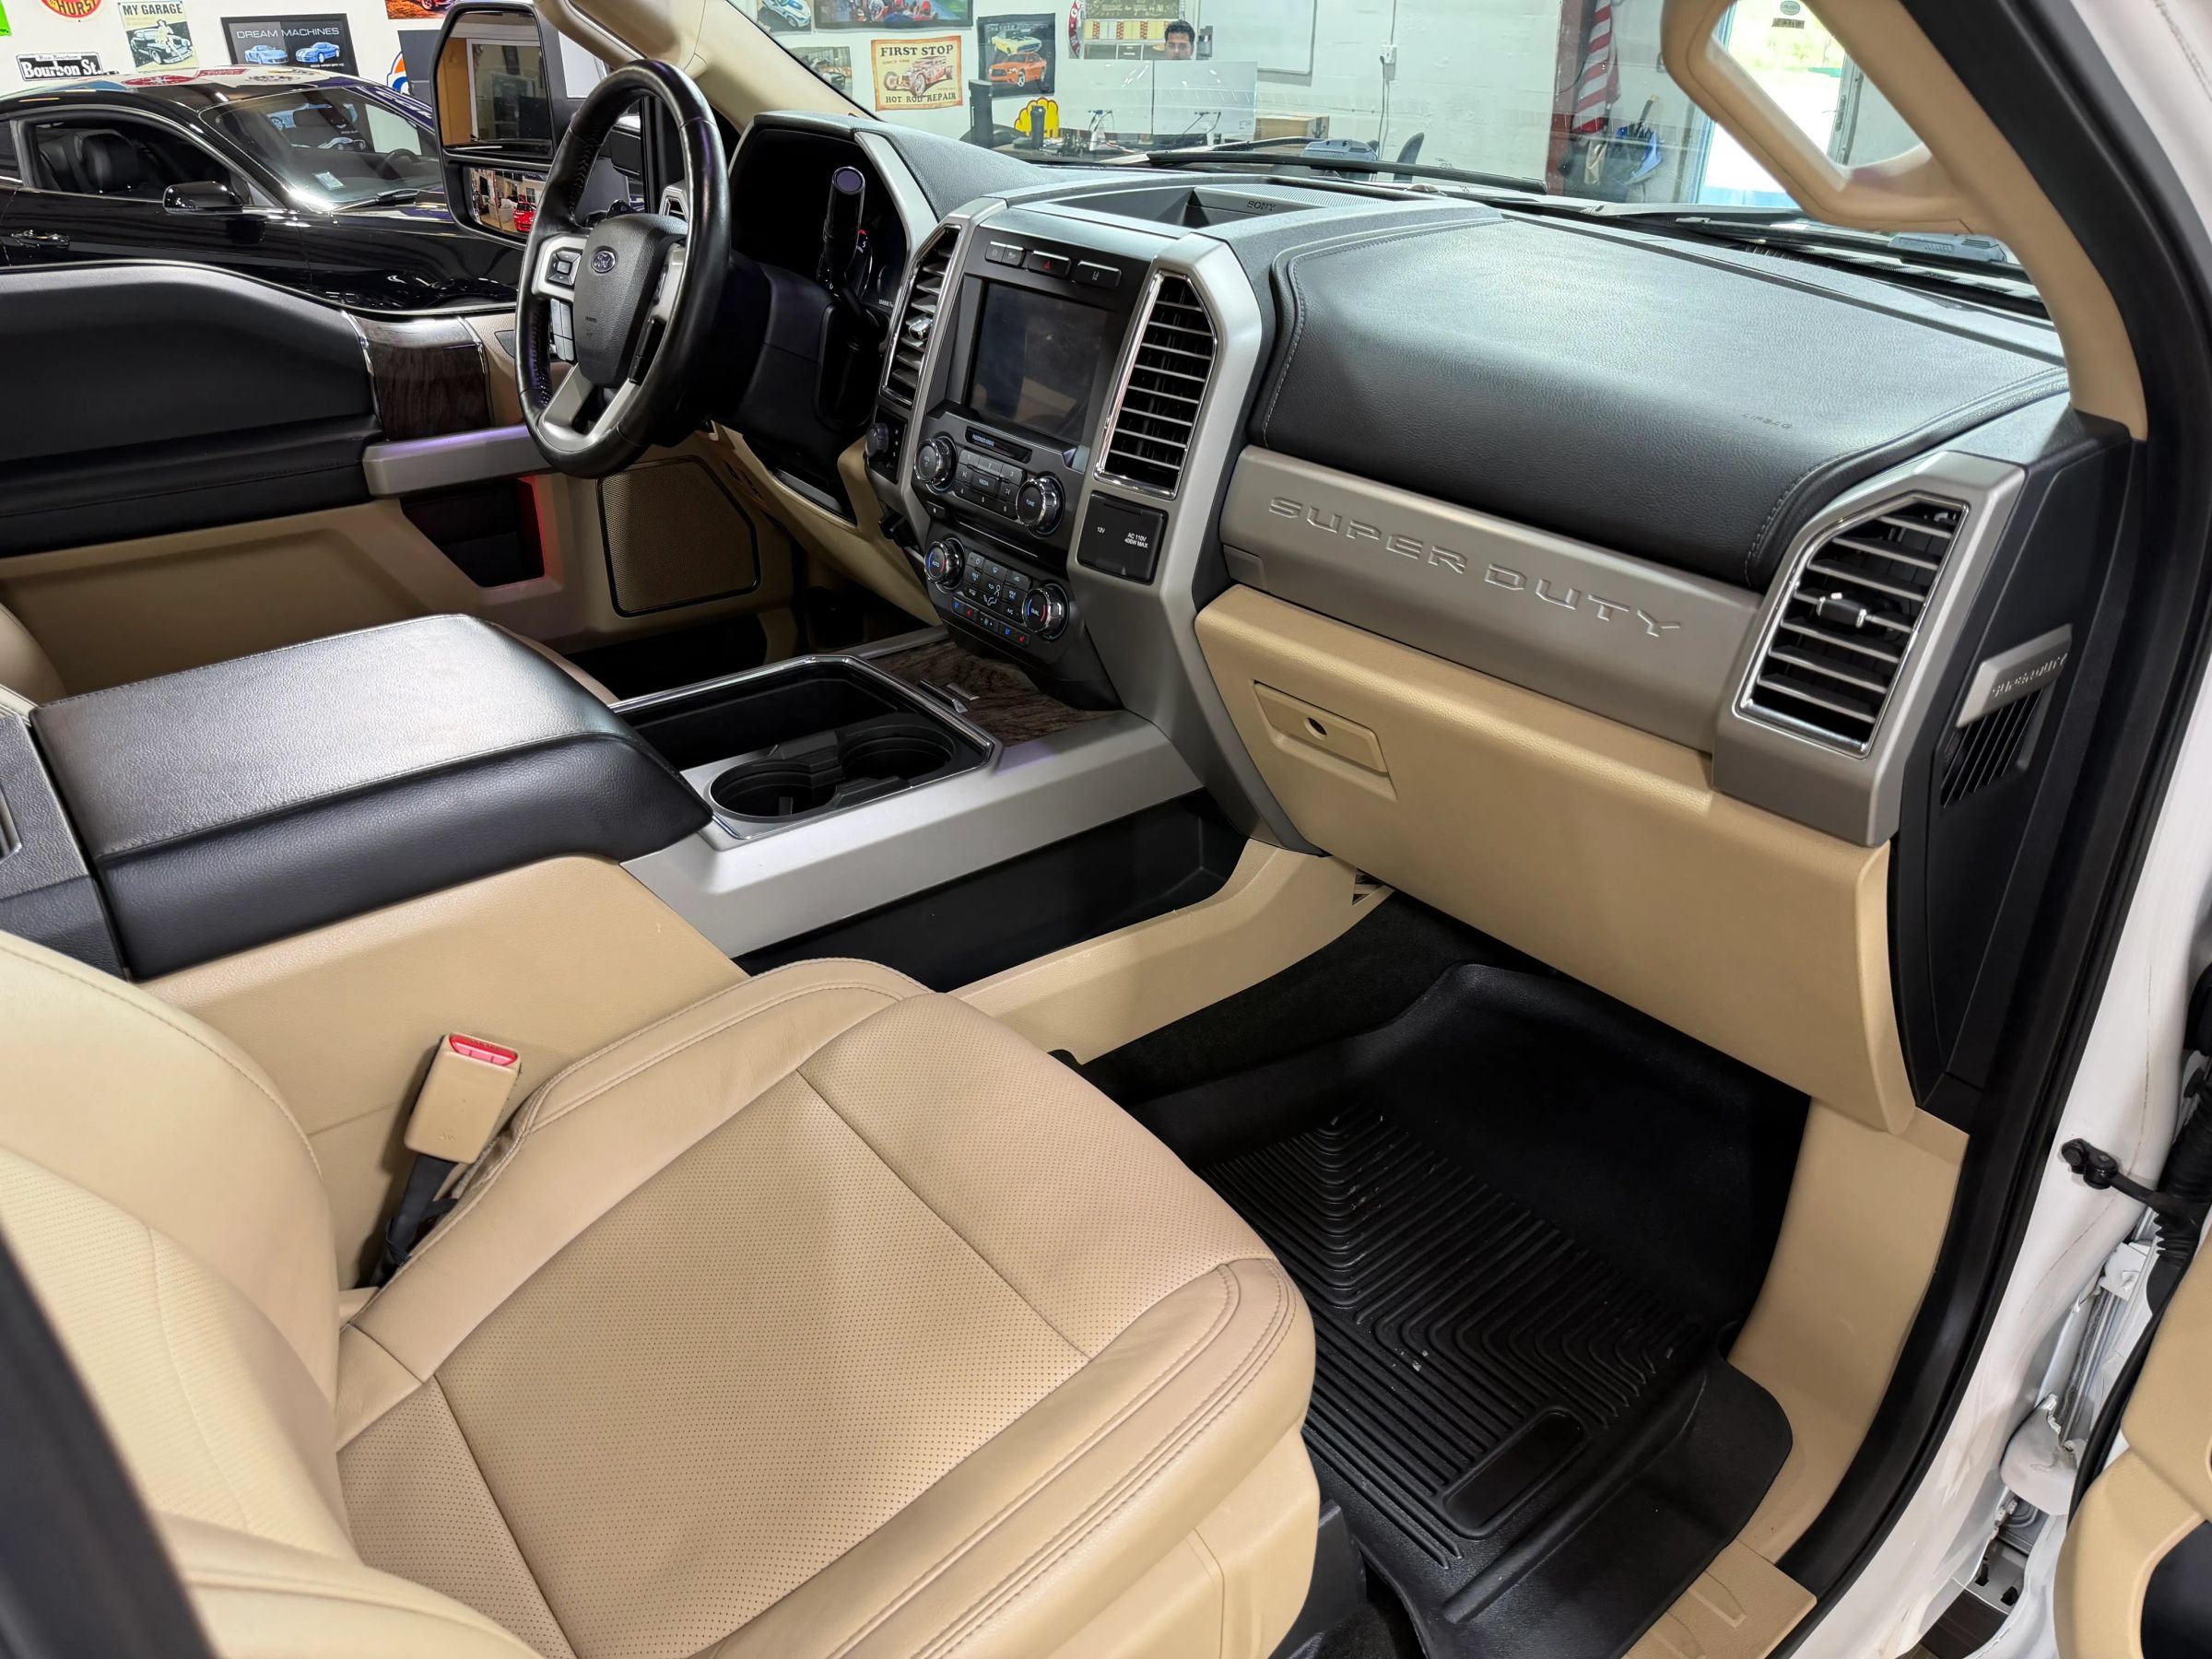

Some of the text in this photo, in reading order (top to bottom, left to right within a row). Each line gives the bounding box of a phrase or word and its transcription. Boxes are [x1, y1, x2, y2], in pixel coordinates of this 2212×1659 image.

[122, 3, 183, 16] MY GARAGE
[236, 27, 340, 39] DREAM MACHINES
[880, 44, 954, 57] FIRST STOP
[20, 59, 101, 78] Bourbon St.
[906, 95, 923, 103] ROD
[926, 92, 957, 102] REPAIR
[1246, 200, 1277, 212] SONY
[1124, 537, 1148, 548] 400W MAX
[1268, 496, 1681, 638] SUPER DUTY
